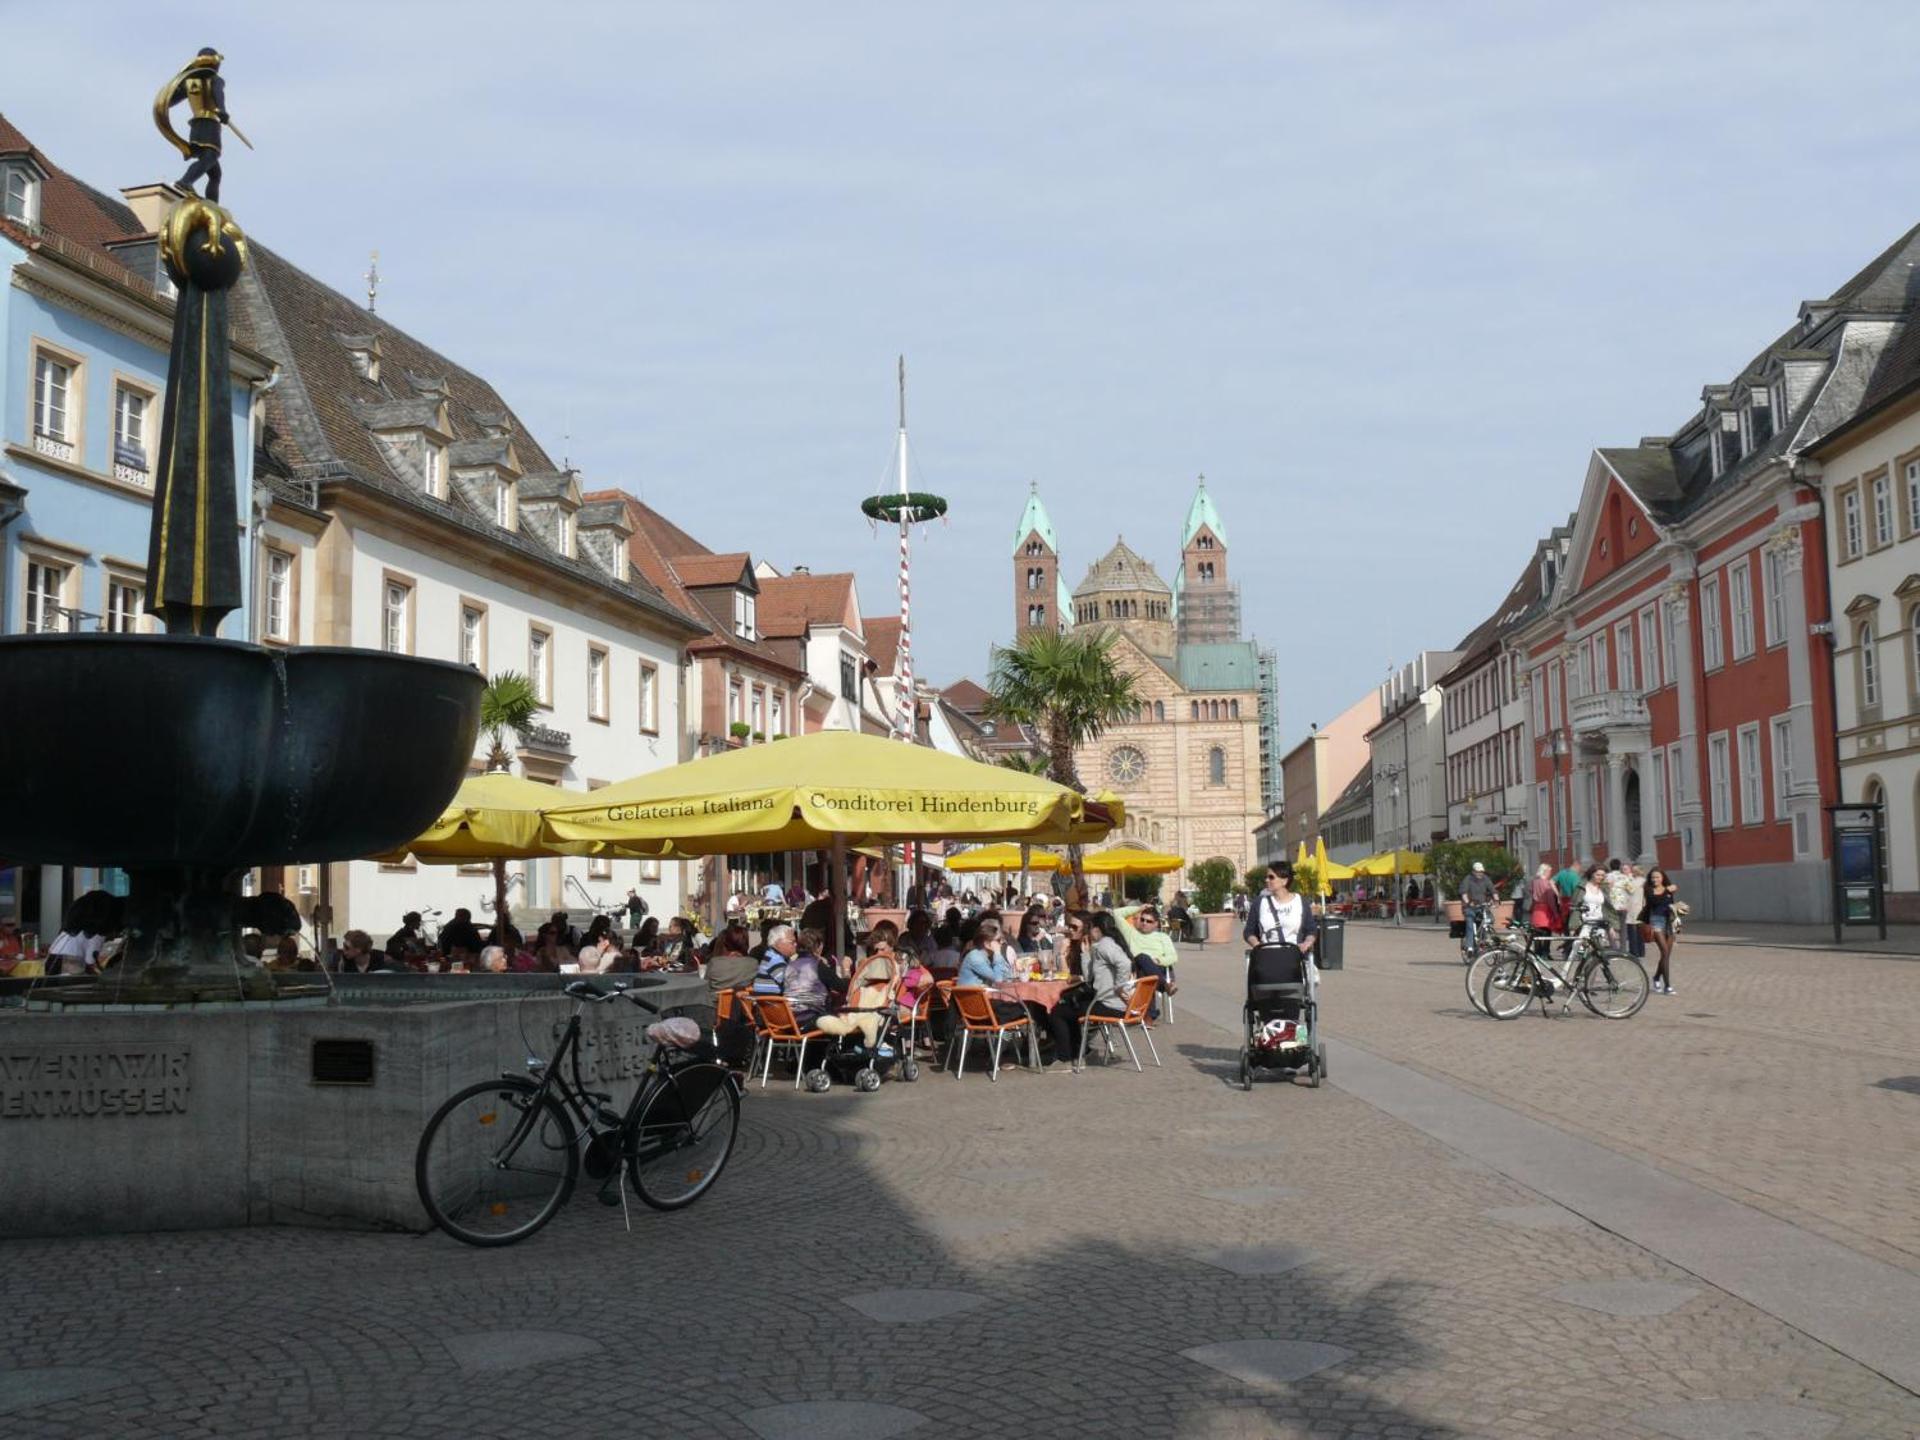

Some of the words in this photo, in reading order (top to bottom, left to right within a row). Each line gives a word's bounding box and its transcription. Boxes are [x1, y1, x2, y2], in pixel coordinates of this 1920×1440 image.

[607, 802, 695, 822] Gelateria
[703, 796, 775, 815] Italiana
[810, 793, 913, 812] Conditorei
[921, 796, 1039, 815] Hindenburg
